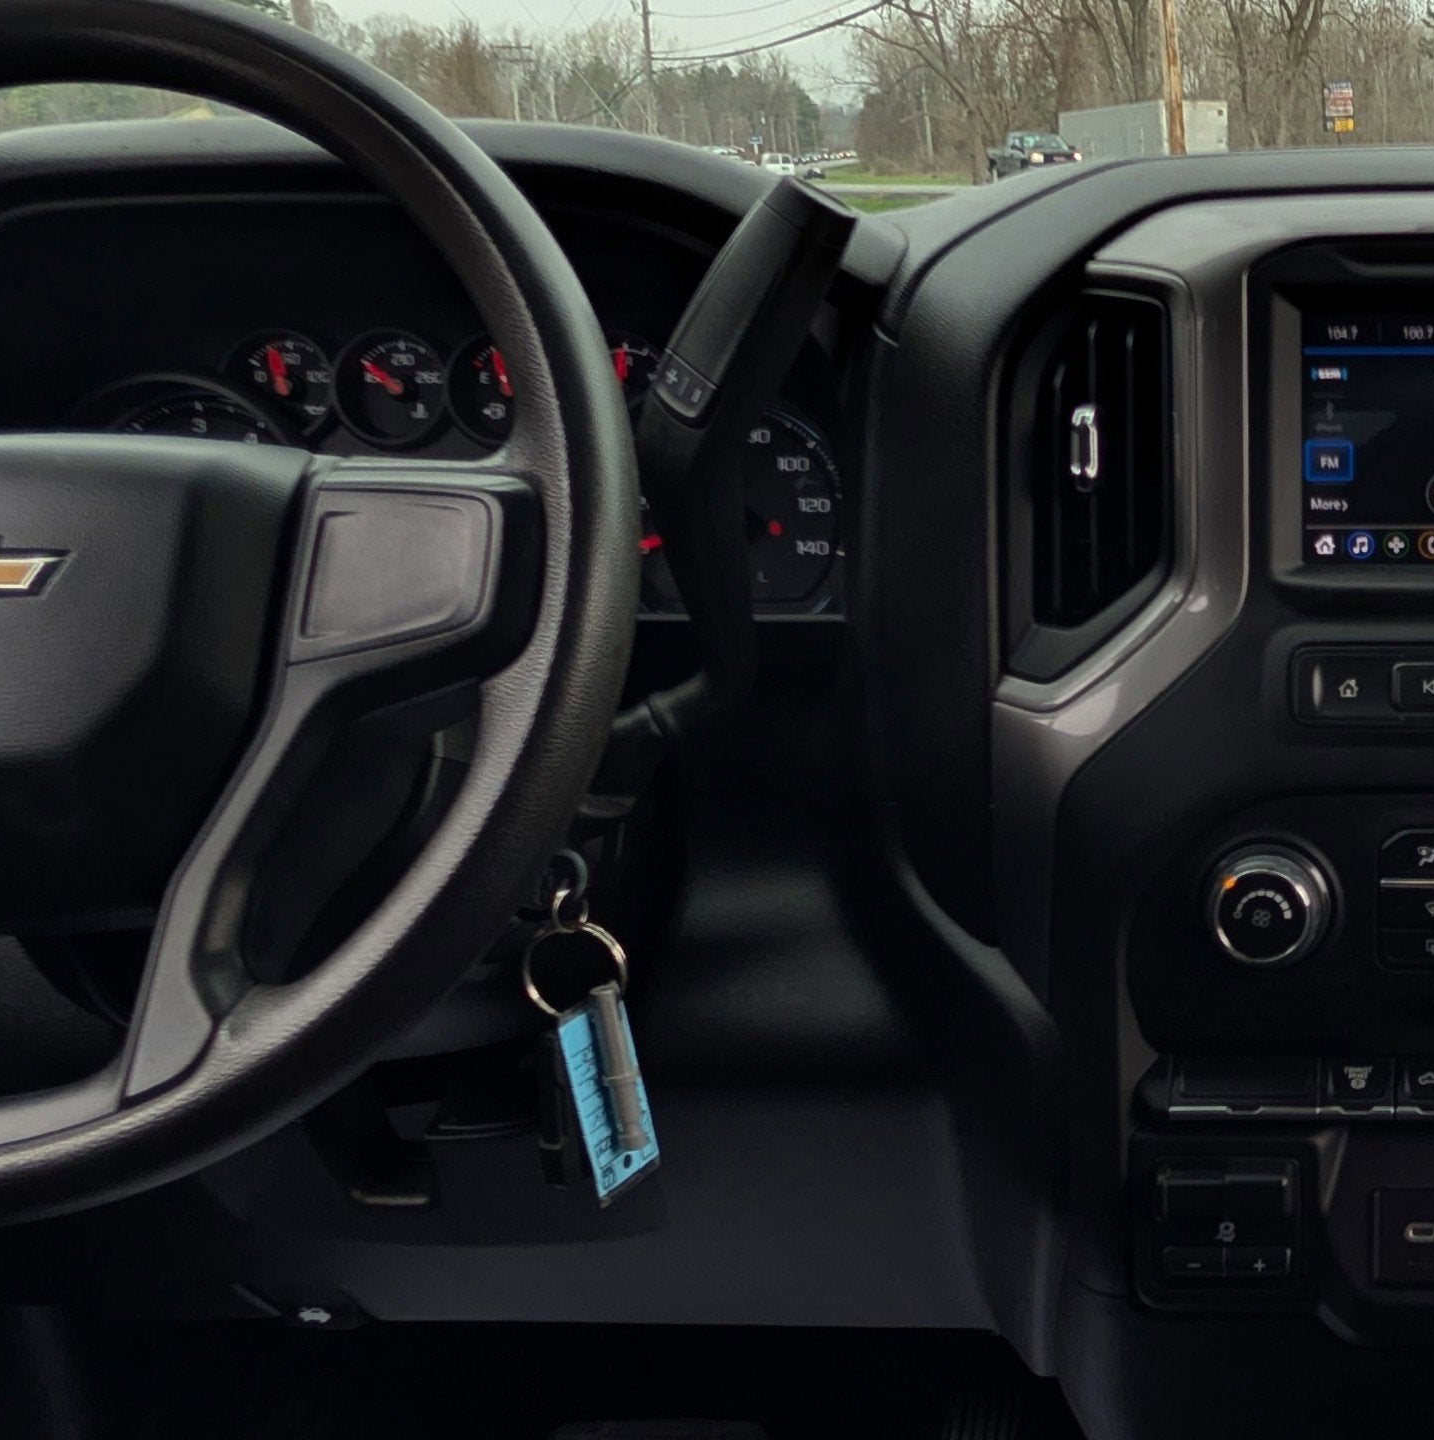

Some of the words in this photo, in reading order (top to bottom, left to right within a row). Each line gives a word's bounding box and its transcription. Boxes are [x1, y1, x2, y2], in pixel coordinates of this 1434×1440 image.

[190, 418, 208, 434] 3
[777, 456, 811, 472] 100
[1320, 455, 1340, 469] FM
[797, 497, 831, 513] 120
[796, 540, 830, 556] 140
